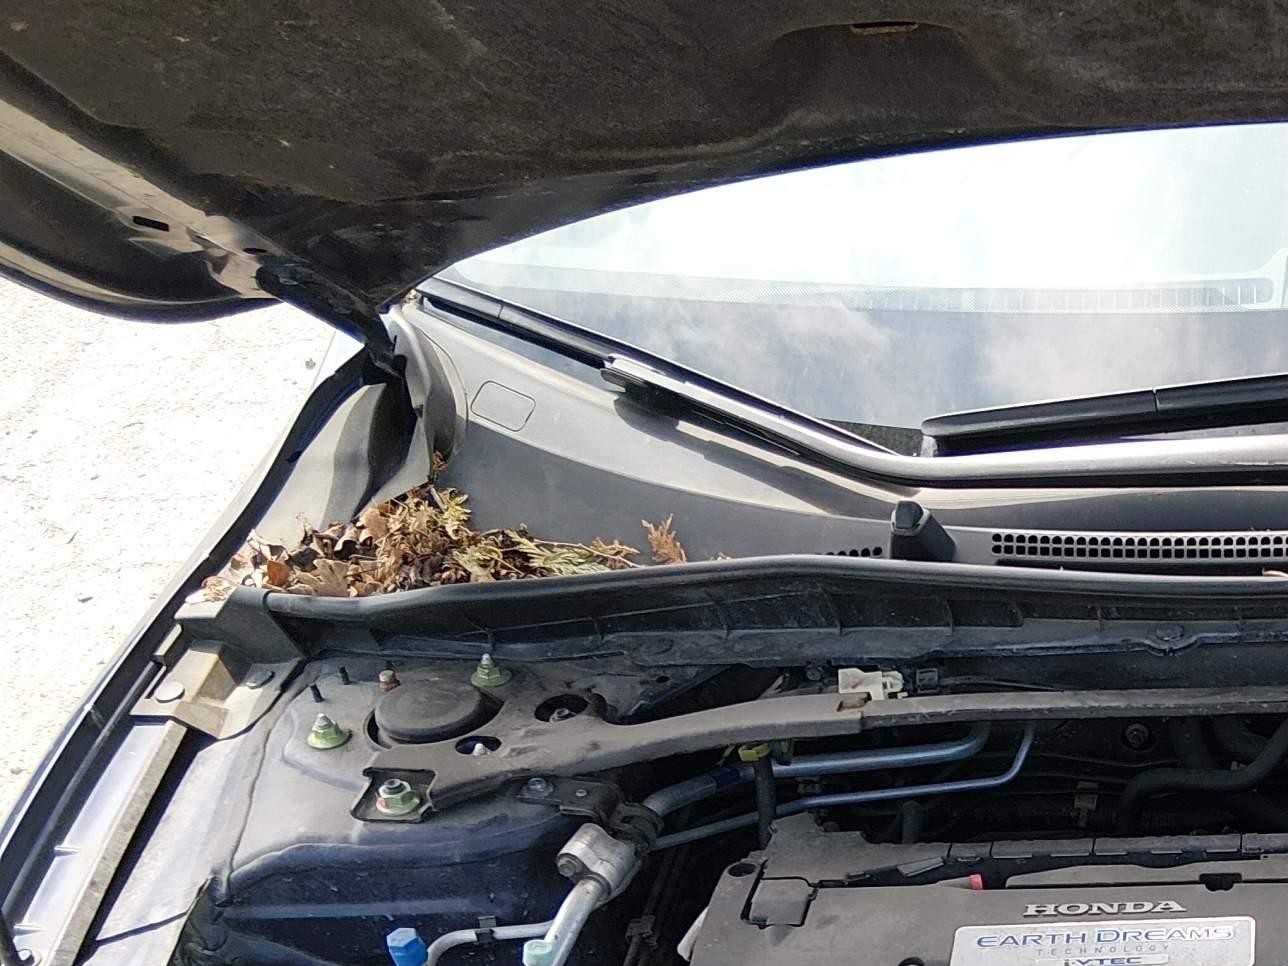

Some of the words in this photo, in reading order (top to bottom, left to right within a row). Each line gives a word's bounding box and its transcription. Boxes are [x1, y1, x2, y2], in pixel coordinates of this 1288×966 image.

[1022, 900, 1187, 918] HONDA
[976, 931, 1087, 949] EARTH
[1094, 926, 1236, 945] DREAMS
[1036, 944, 1172, 957] TECHNOLOGY
